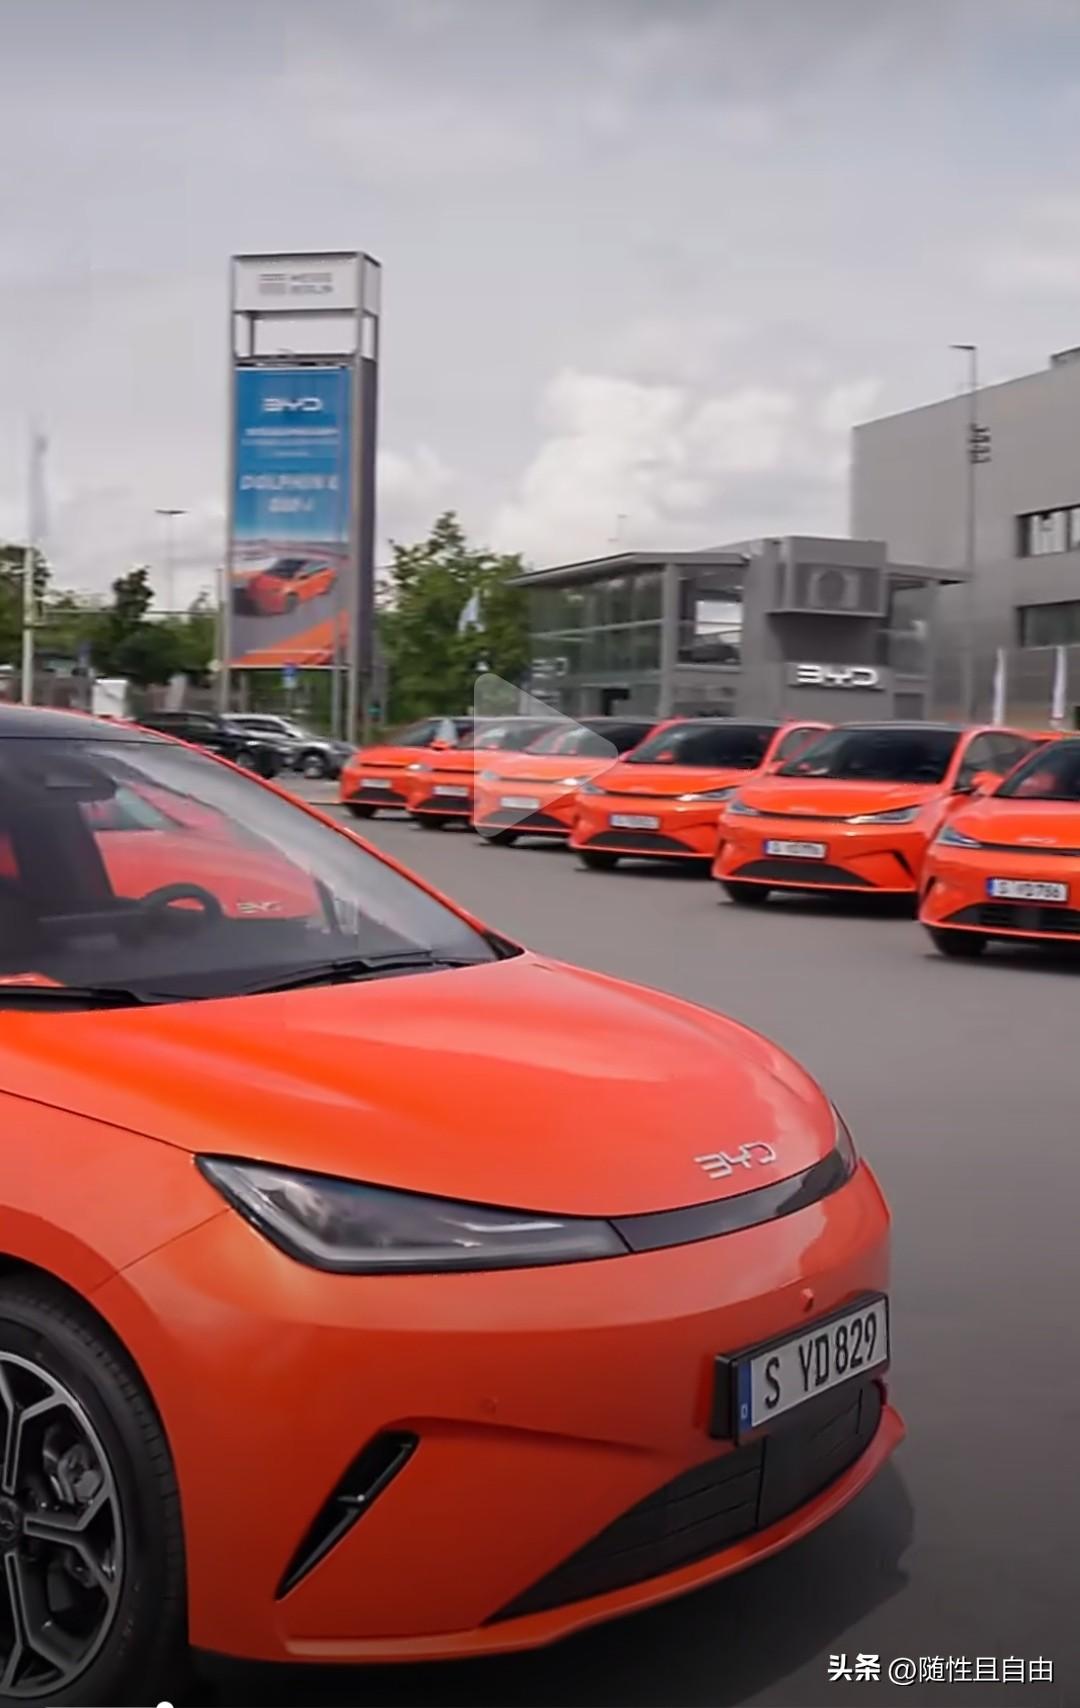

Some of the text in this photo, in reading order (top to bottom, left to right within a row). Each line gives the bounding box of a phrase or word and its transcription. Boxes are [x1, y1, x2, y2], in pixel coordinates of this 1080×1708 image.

[797, 664, 879, 686] BYD
[693, 1141, 777, 1179] BYD
[765, 1356, 780, 1410] S
